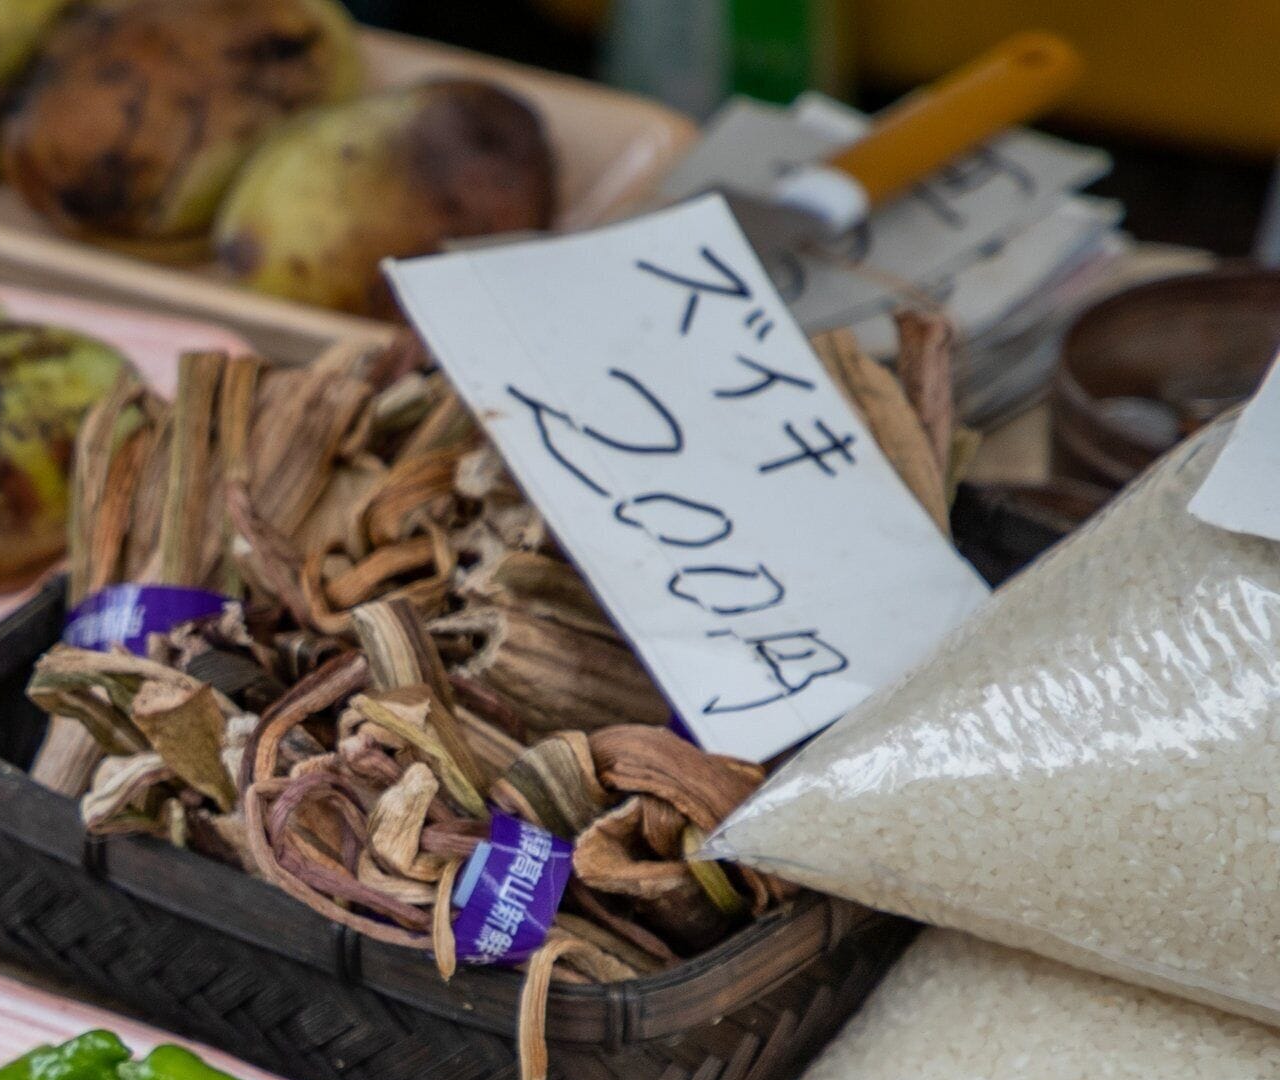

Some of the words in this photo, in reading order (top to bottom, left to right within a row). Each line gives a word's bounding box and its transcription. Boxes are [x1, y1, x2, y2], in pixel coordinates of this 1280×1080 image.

[635, 247, 857, 477] ズイキ
[506, 367, 849, 714] 200円
